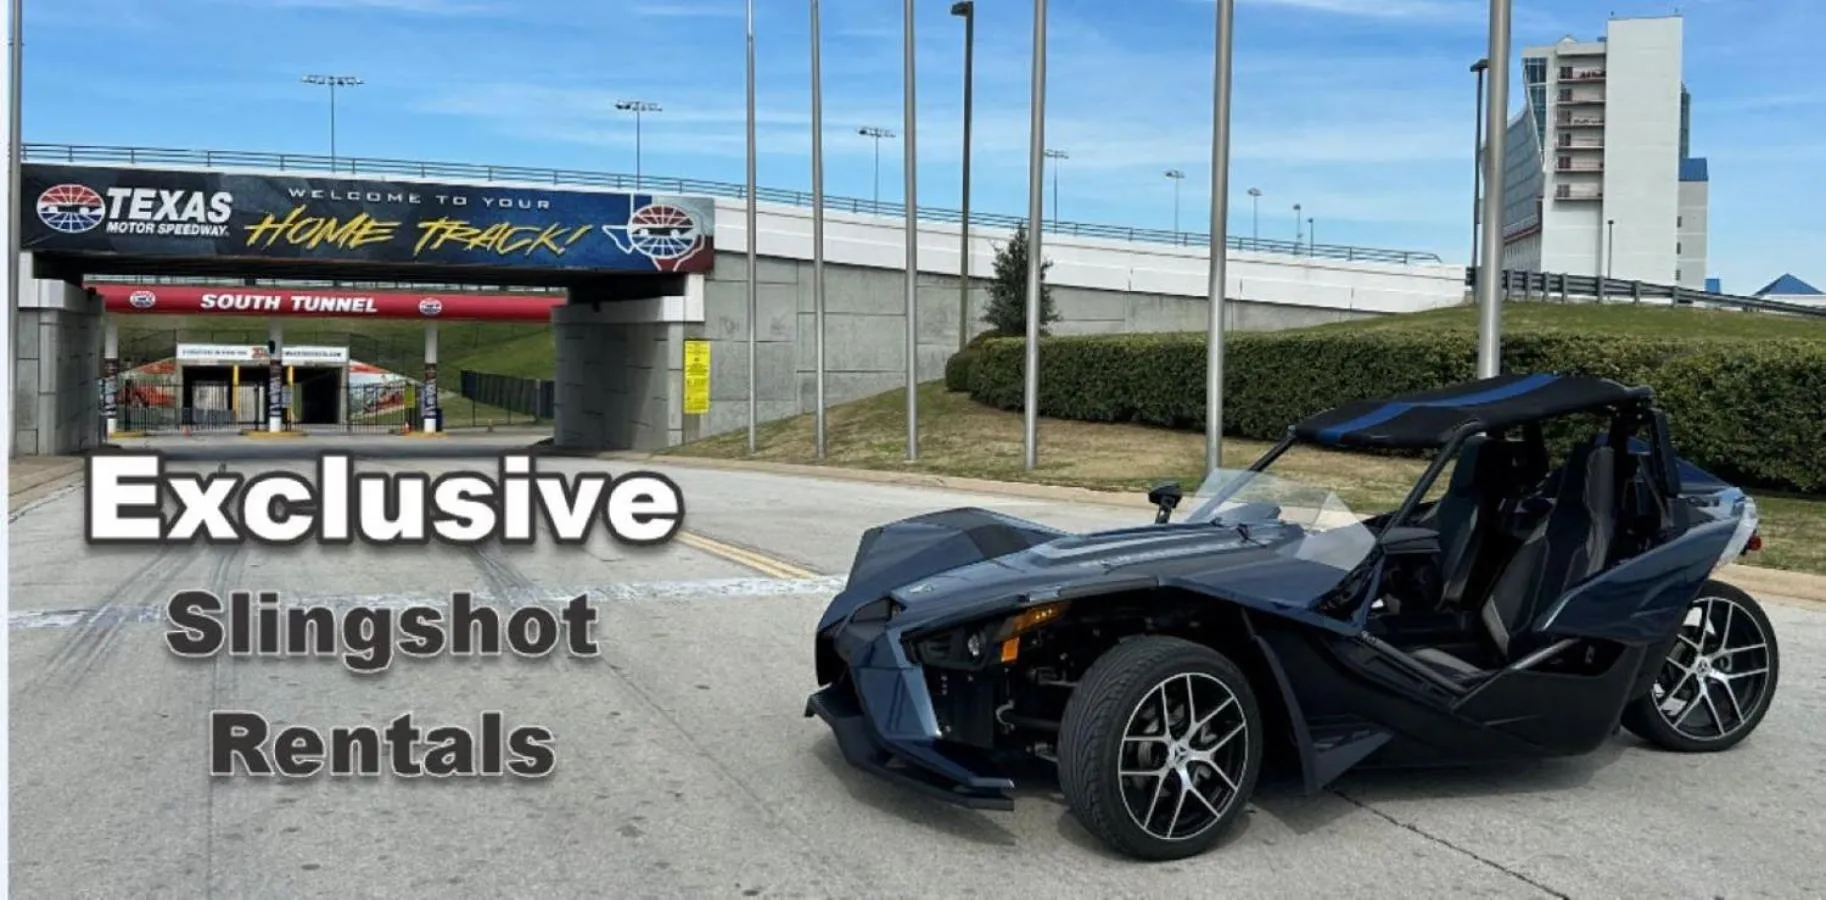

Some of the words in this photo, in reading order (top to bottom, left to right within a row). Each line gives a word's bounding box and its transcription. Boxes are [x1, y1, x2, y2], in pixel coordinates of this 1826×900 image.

[106, 187, 233, 224] TEXAS
[288, 187, 421, 205] WELCOME
[436, 195, 468, 206] TO
[482, 197, 551, 210] YOUR
[106, 220, 155, 235] MOTOR
[244, 204, 402, 250] HOME
[416, 216, 593, 257] TRACK!
[200, 293, 281, 311] SOUTH
[290, 295, 379, 314] TUNNEL
